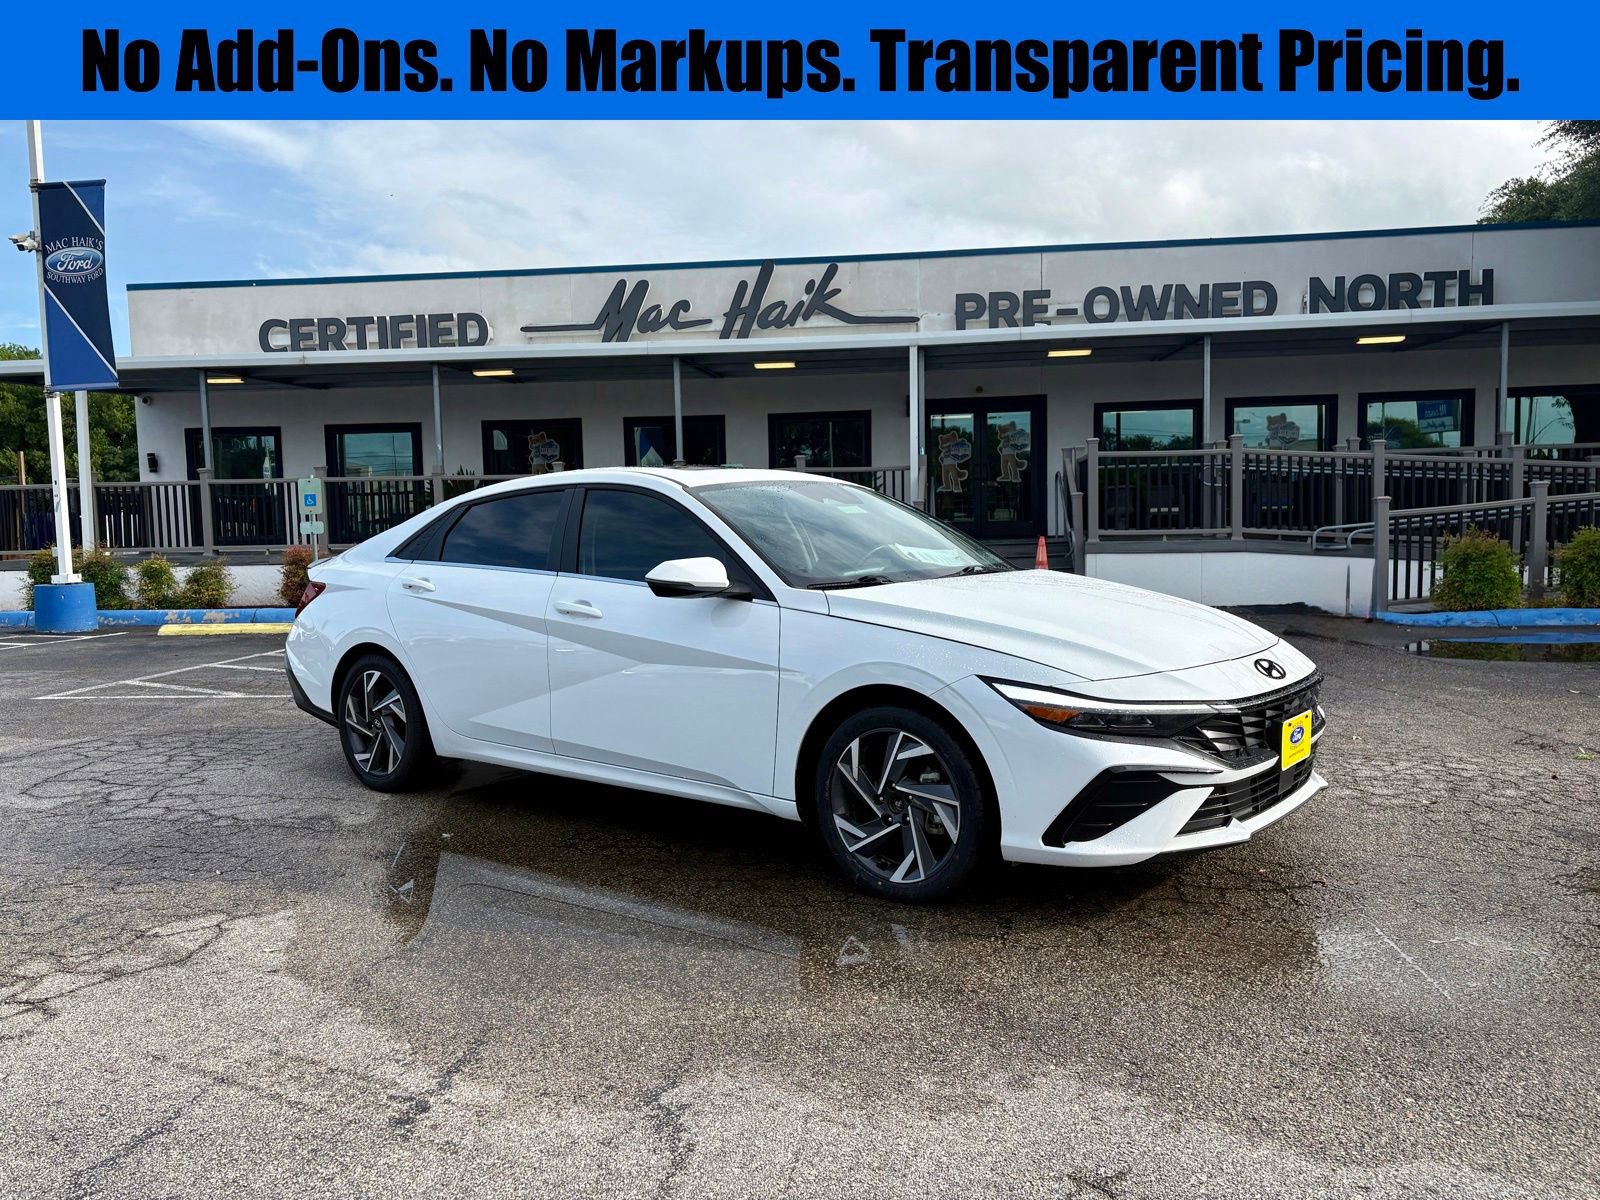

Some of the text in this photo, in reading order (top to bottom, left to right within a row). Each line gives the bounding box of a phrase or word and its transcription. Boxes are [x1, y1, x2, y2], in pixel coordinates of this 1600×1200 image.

[45, 236, 103, 254] MAC HAIK'S
[46, 267, 103, 283] SOUTHWAY FORD
[57, 252, 93, 271] Ford
[520, 259, 920, 343] Mac Haik
[955, 268, 1495, 331] PRE-OWNED NORTH
[258, 312, 489, 353] CERTIFIED
